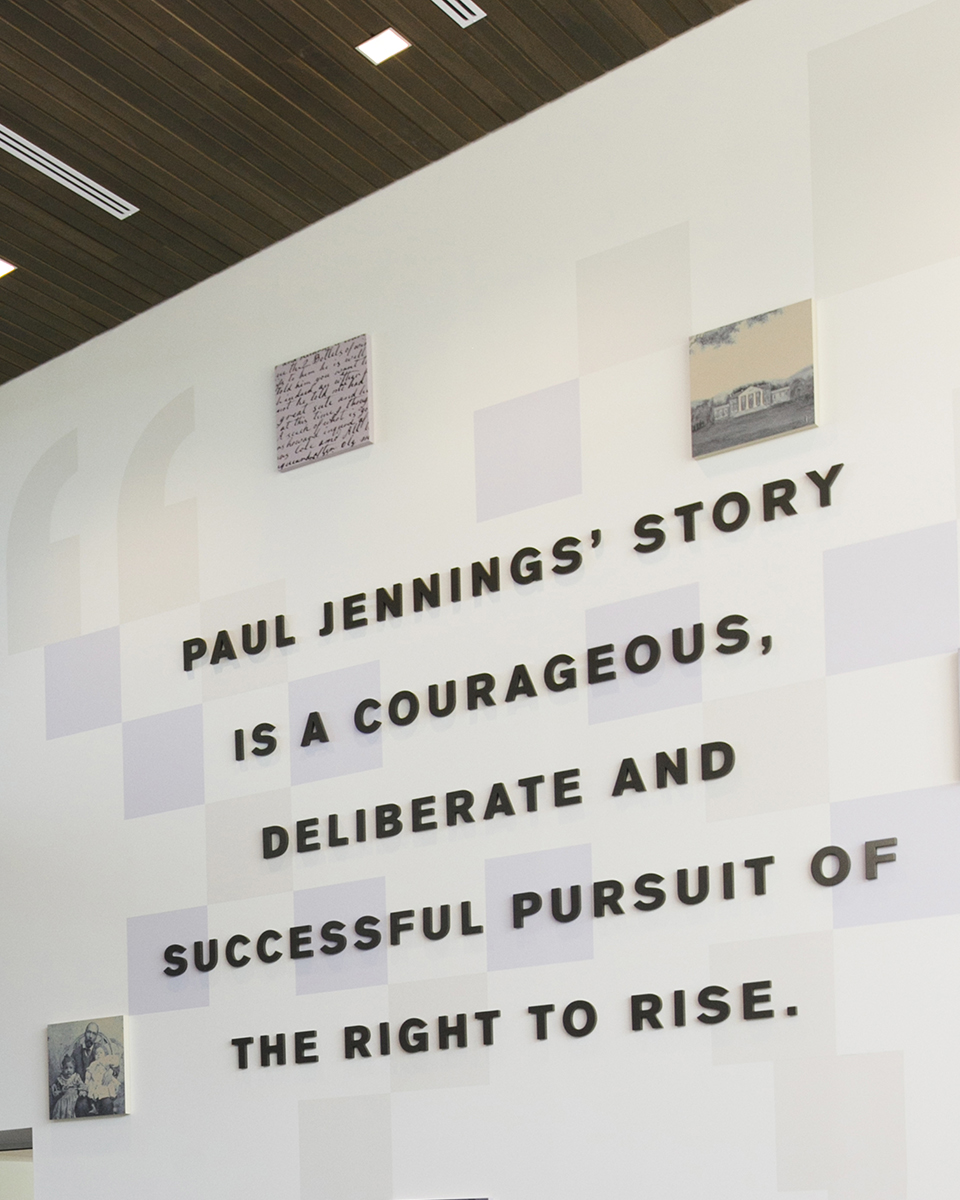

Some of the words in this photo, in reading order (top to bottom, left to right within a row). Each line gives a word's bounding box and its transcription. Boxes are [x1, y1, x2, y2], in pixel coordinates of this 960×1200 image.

[183, 615, 295, 671] PAUL
[319, 529, 601, 636] JENNINGS’
[634, 464, 843, 553] STORY
[235, 723, 276, 761] IS
[301, 712, 329, 747] A
[354, 615, 771, 734] COURAGEOUS,
[263, 769, 581, 859] DELIBERATE
[612, 742, 734, 796] AND
[163, 901, 483, 977] SUCCESSFUL
[513, 856, 774, 929] PURSUIT
[811, 838, 896, 886] OF
[231, 1031, 318, 1069] THE
[344, 1010, 500, 1059] RIGHT
[528, 1000, 597, 1040] TO
[631, 981, 797, 1031] RISE.
